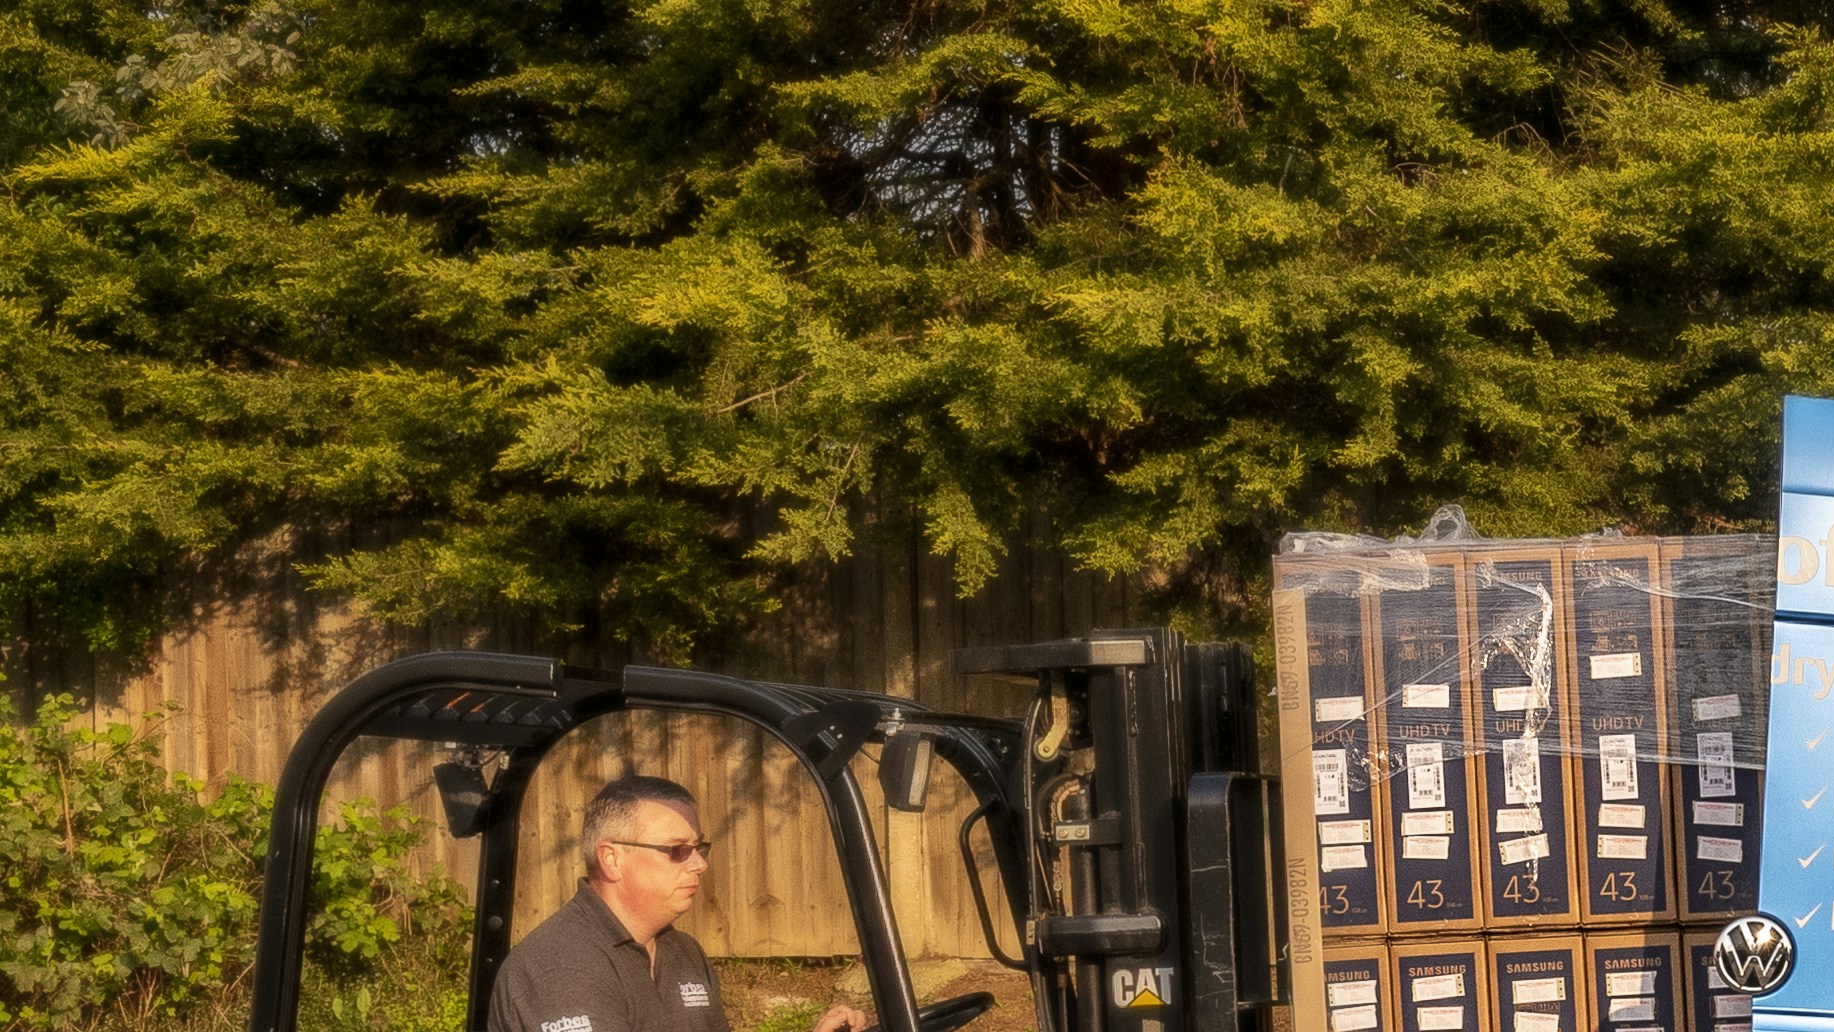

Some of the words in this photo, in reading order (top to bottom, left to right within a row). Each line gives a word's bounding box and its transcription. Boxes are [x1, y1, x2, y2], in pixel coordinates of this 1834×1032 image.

[1407, 880, 1444, 909] 43
[1503, 875, 1540, 903] 43
[1600, 872, 1638, 901] 43
[1698, 870, 1735, 899] 43
[1319, 885, 1349, 915] 43
[1409, 965, 1466, 977] SAMSUNG
[1507, 961, 1564, 974] SAMSUNG
[1605, 957, 1662, 970] SAMSUNG
[1112, 968, 1174, 1008] CAT
